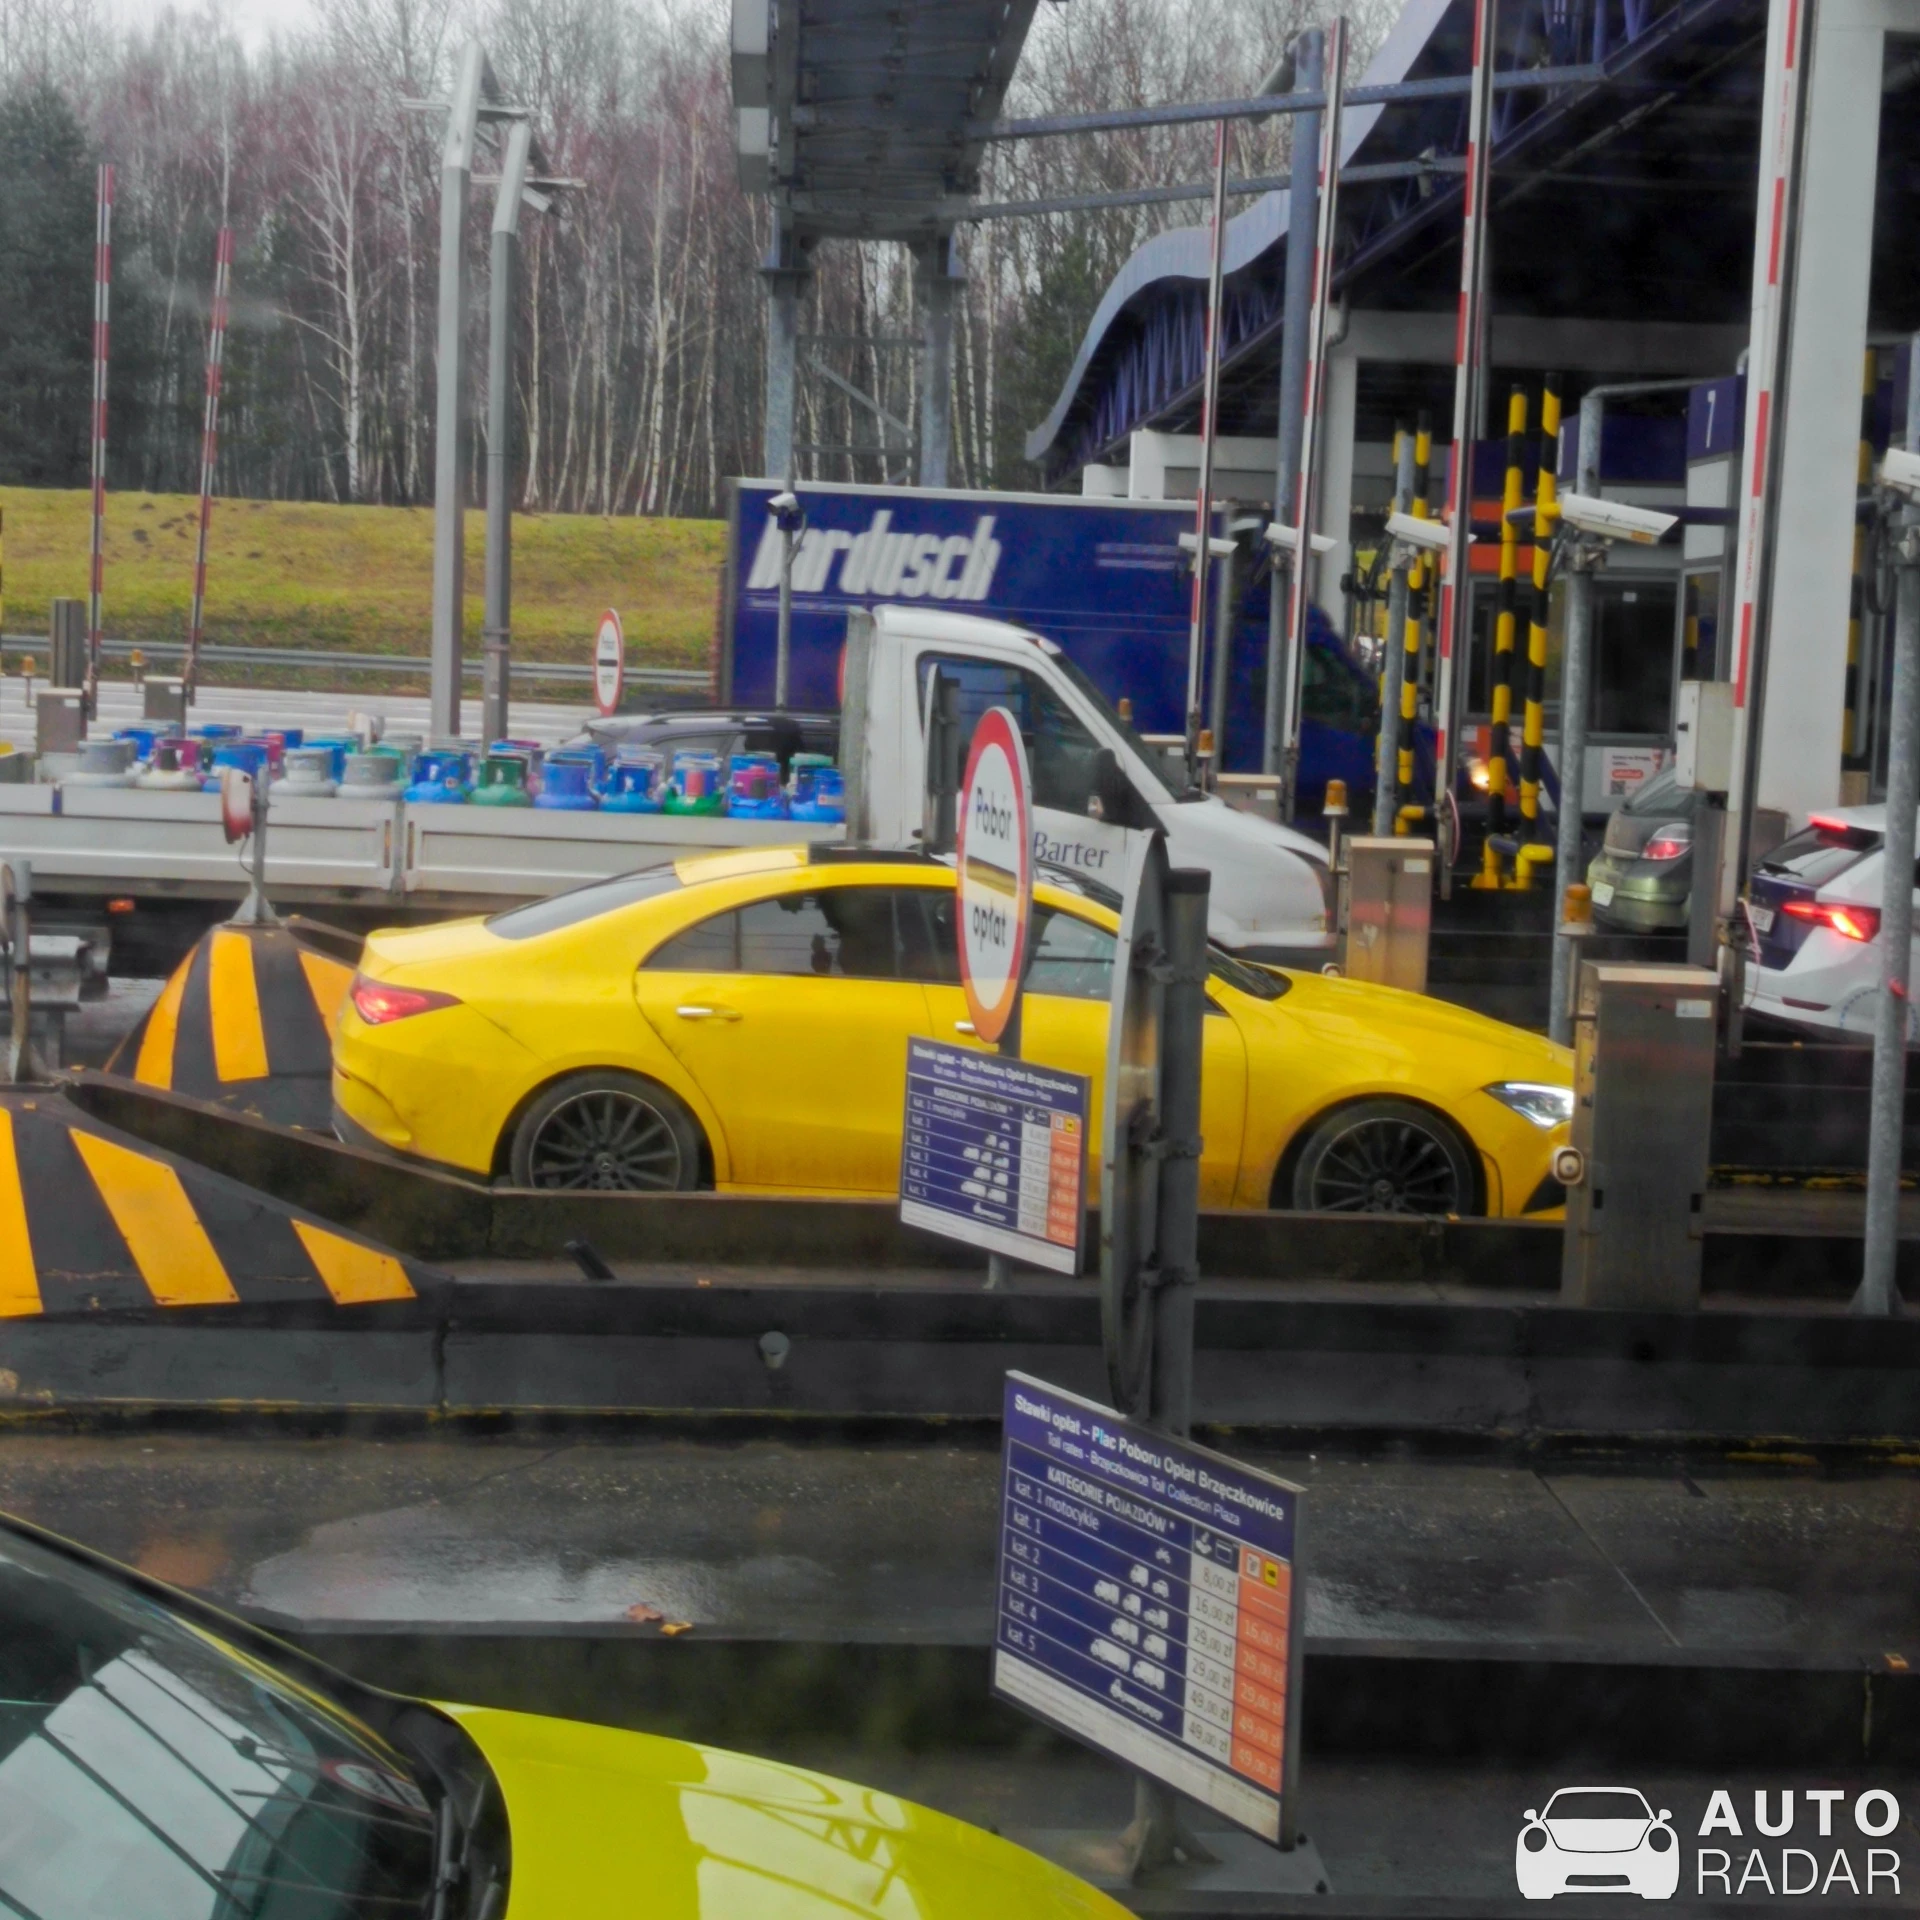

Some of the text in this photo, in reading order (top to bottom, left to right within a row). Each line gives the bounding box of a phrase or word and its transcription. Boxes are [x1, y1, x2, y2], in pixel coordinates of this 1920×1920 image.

[1033, 831, 1110, 868] Barter
[1092, 1425, 1117, 1450] Plac
[1118, 1437, 1160, 1468] Poboru
[1198, 1470, 1284, 1520] Brzęczkowice
[1047, 1465, 1103, 1504] KATEGORIE
[1037, 1488, 1042, 1504] 1
[1167, 1483, 1212, 1513] Collection
[1035, 1518, 1041, 1534] 1
[1033, 1548, 1040, 1565] 2
[1032, 1576, 1038, 1593] 3
[1030, 1606, 1037, 1622] 4
[1029, 1635, 1036, 1651] 5
